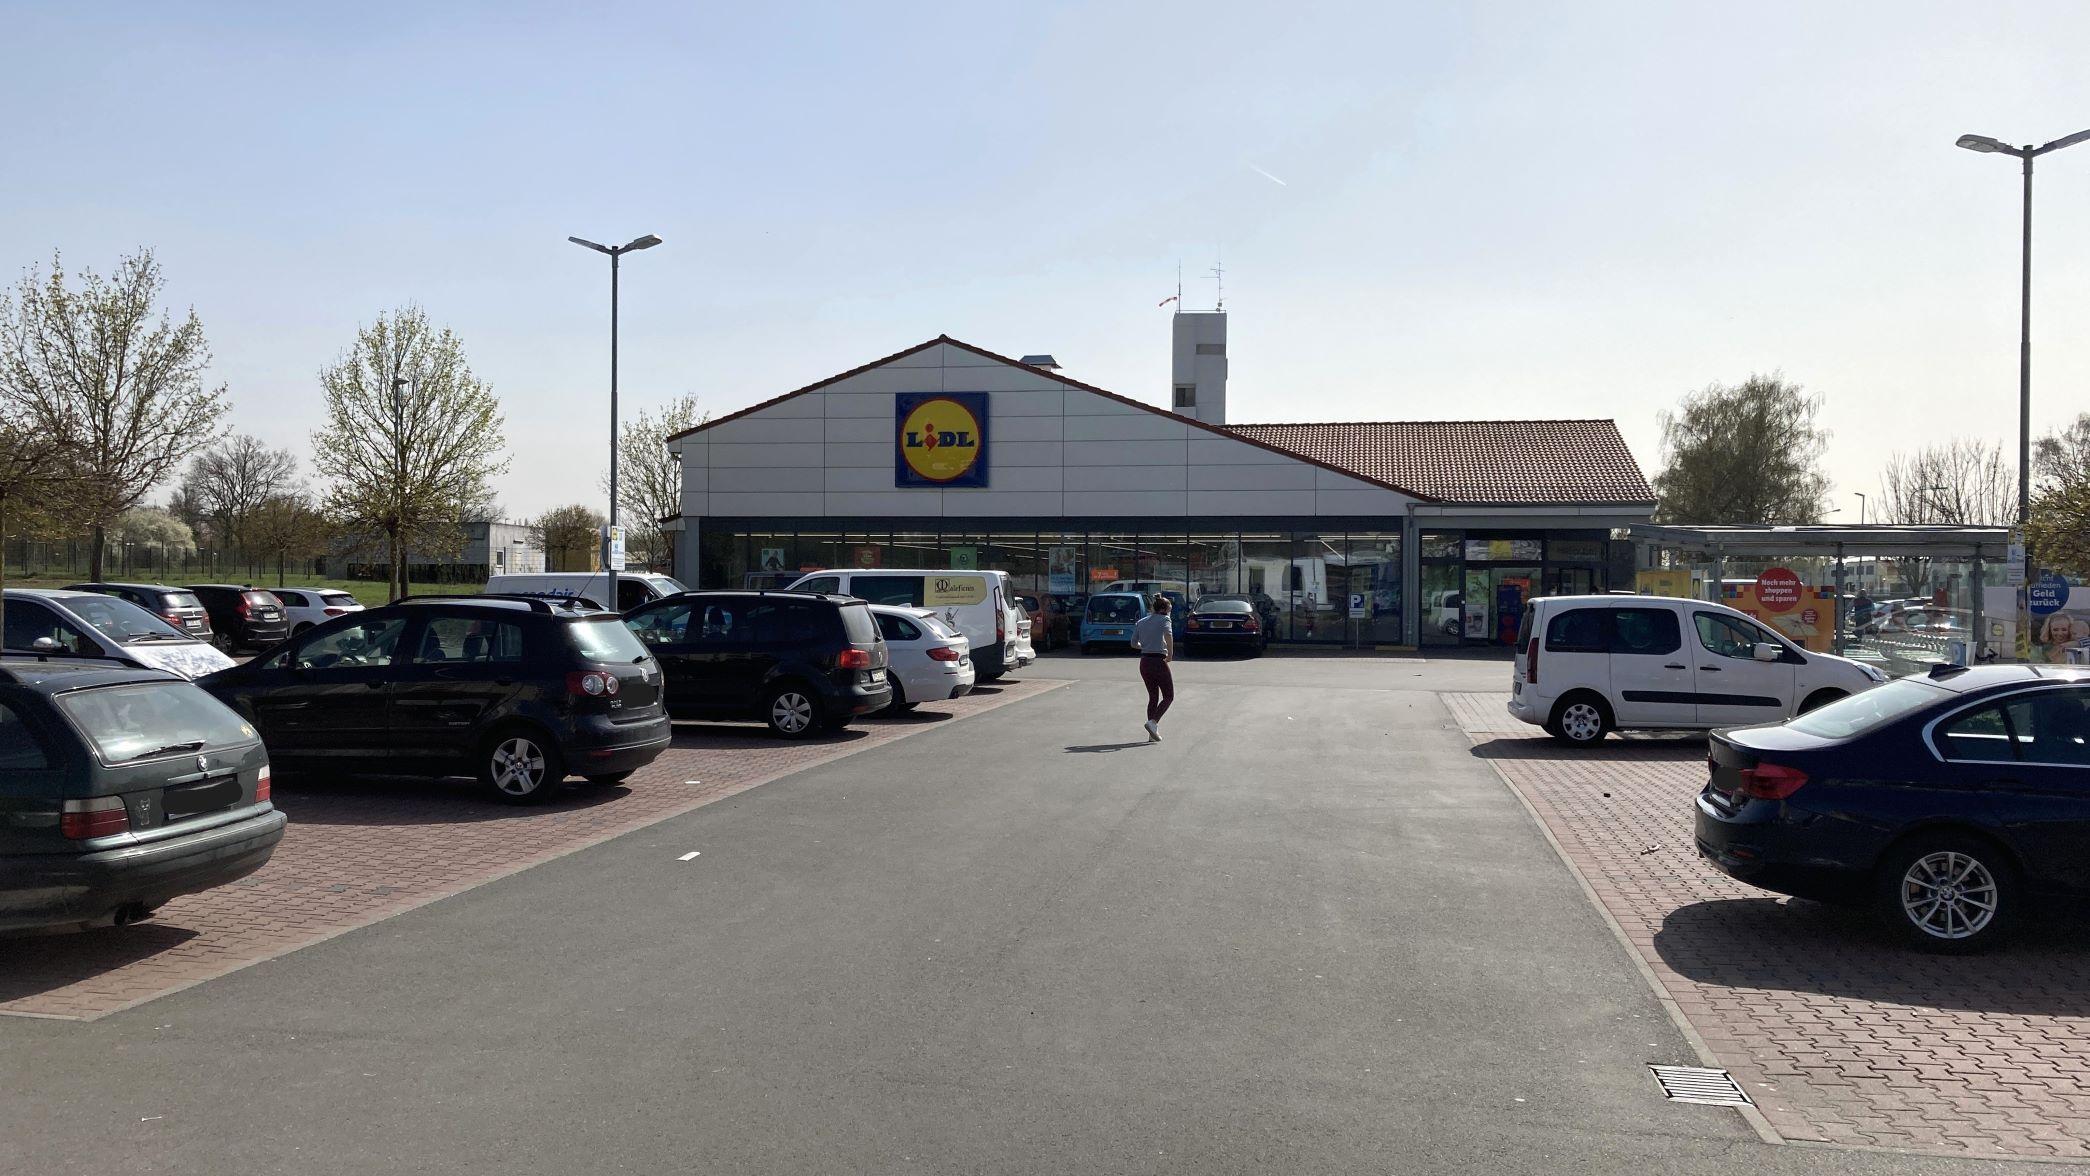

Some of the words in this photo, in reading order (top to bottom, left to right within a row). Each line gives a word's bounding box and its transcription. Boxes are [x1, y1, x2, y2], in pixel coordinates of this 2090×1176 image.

[1764, 587, 1793, 595] shoppen
[2032, 589, 2056, 598] Geld
[1350, 594, 1362, 609] P
[1775, 595, 1797, 603] sparen
